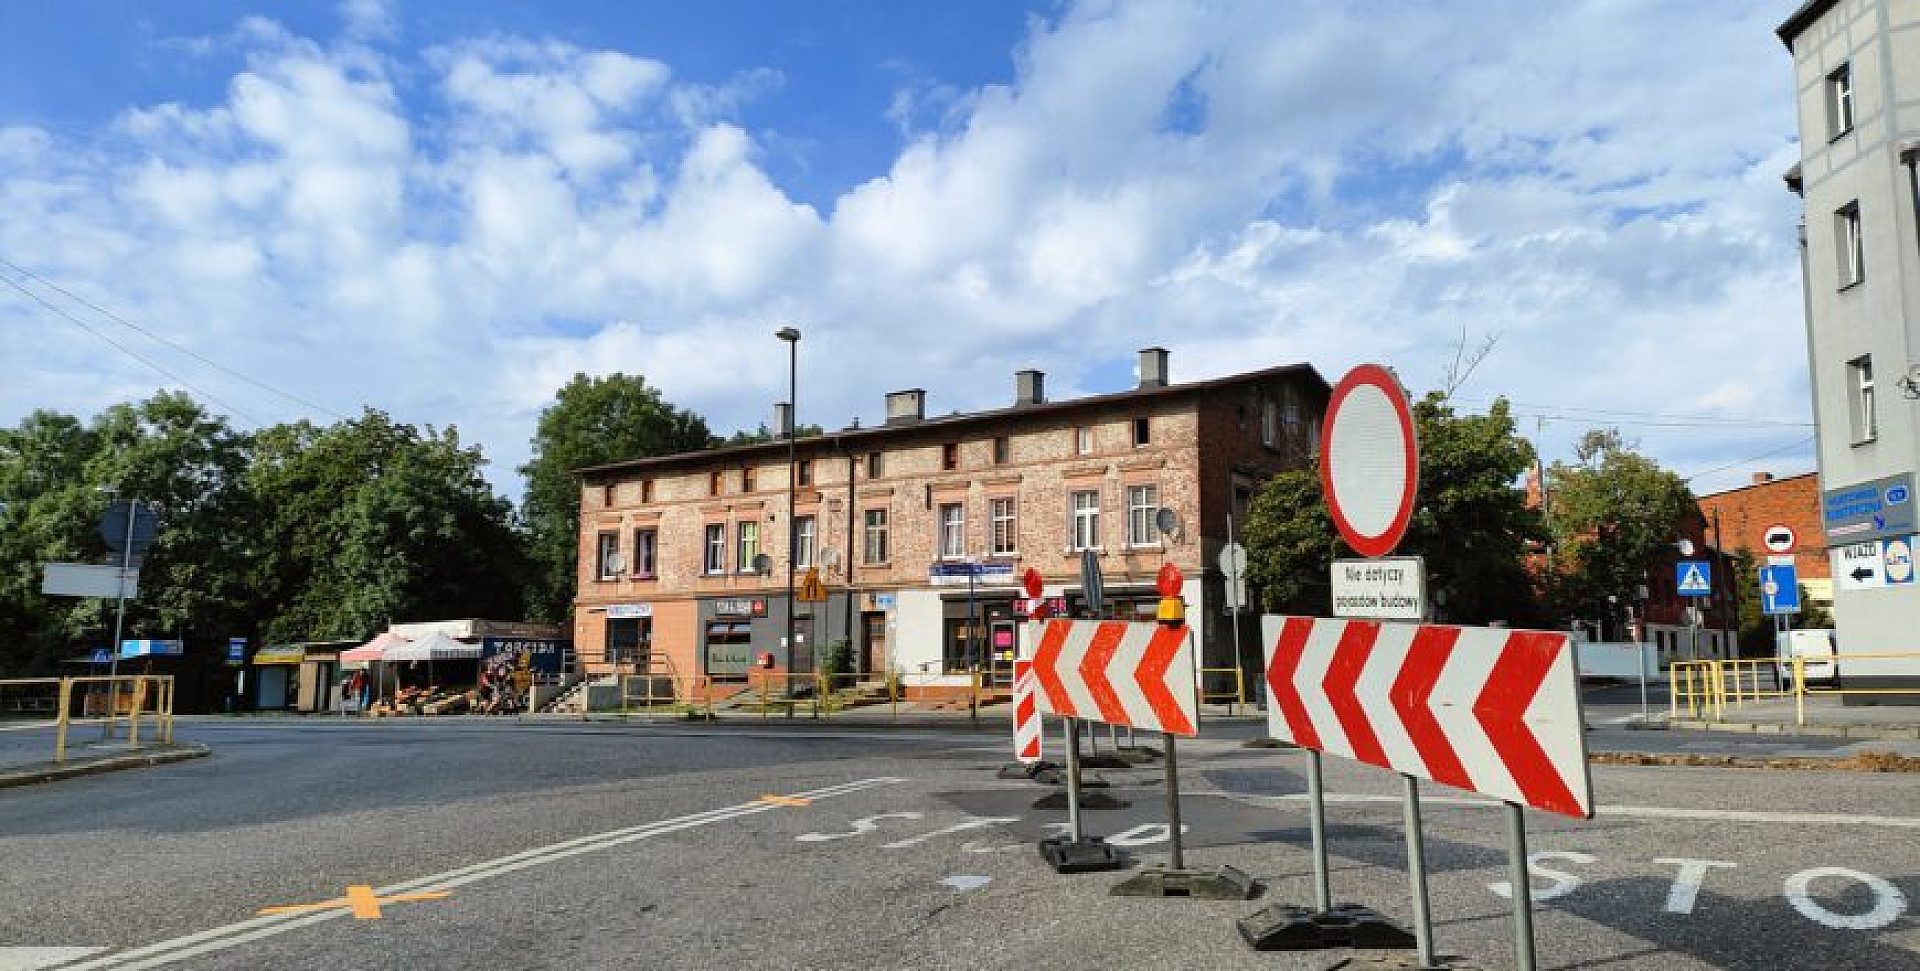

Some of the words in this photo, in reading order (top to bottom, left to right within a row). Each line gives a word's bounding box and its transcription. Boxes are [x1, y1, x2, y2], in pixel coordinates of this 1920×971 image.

[1345, 565, 1362, 582] Nie
[1365, 565, 1404, 586] dotyczy
[1380, 591, 1418, 613] budowy
[1487, 850, 1908, 930] STO
